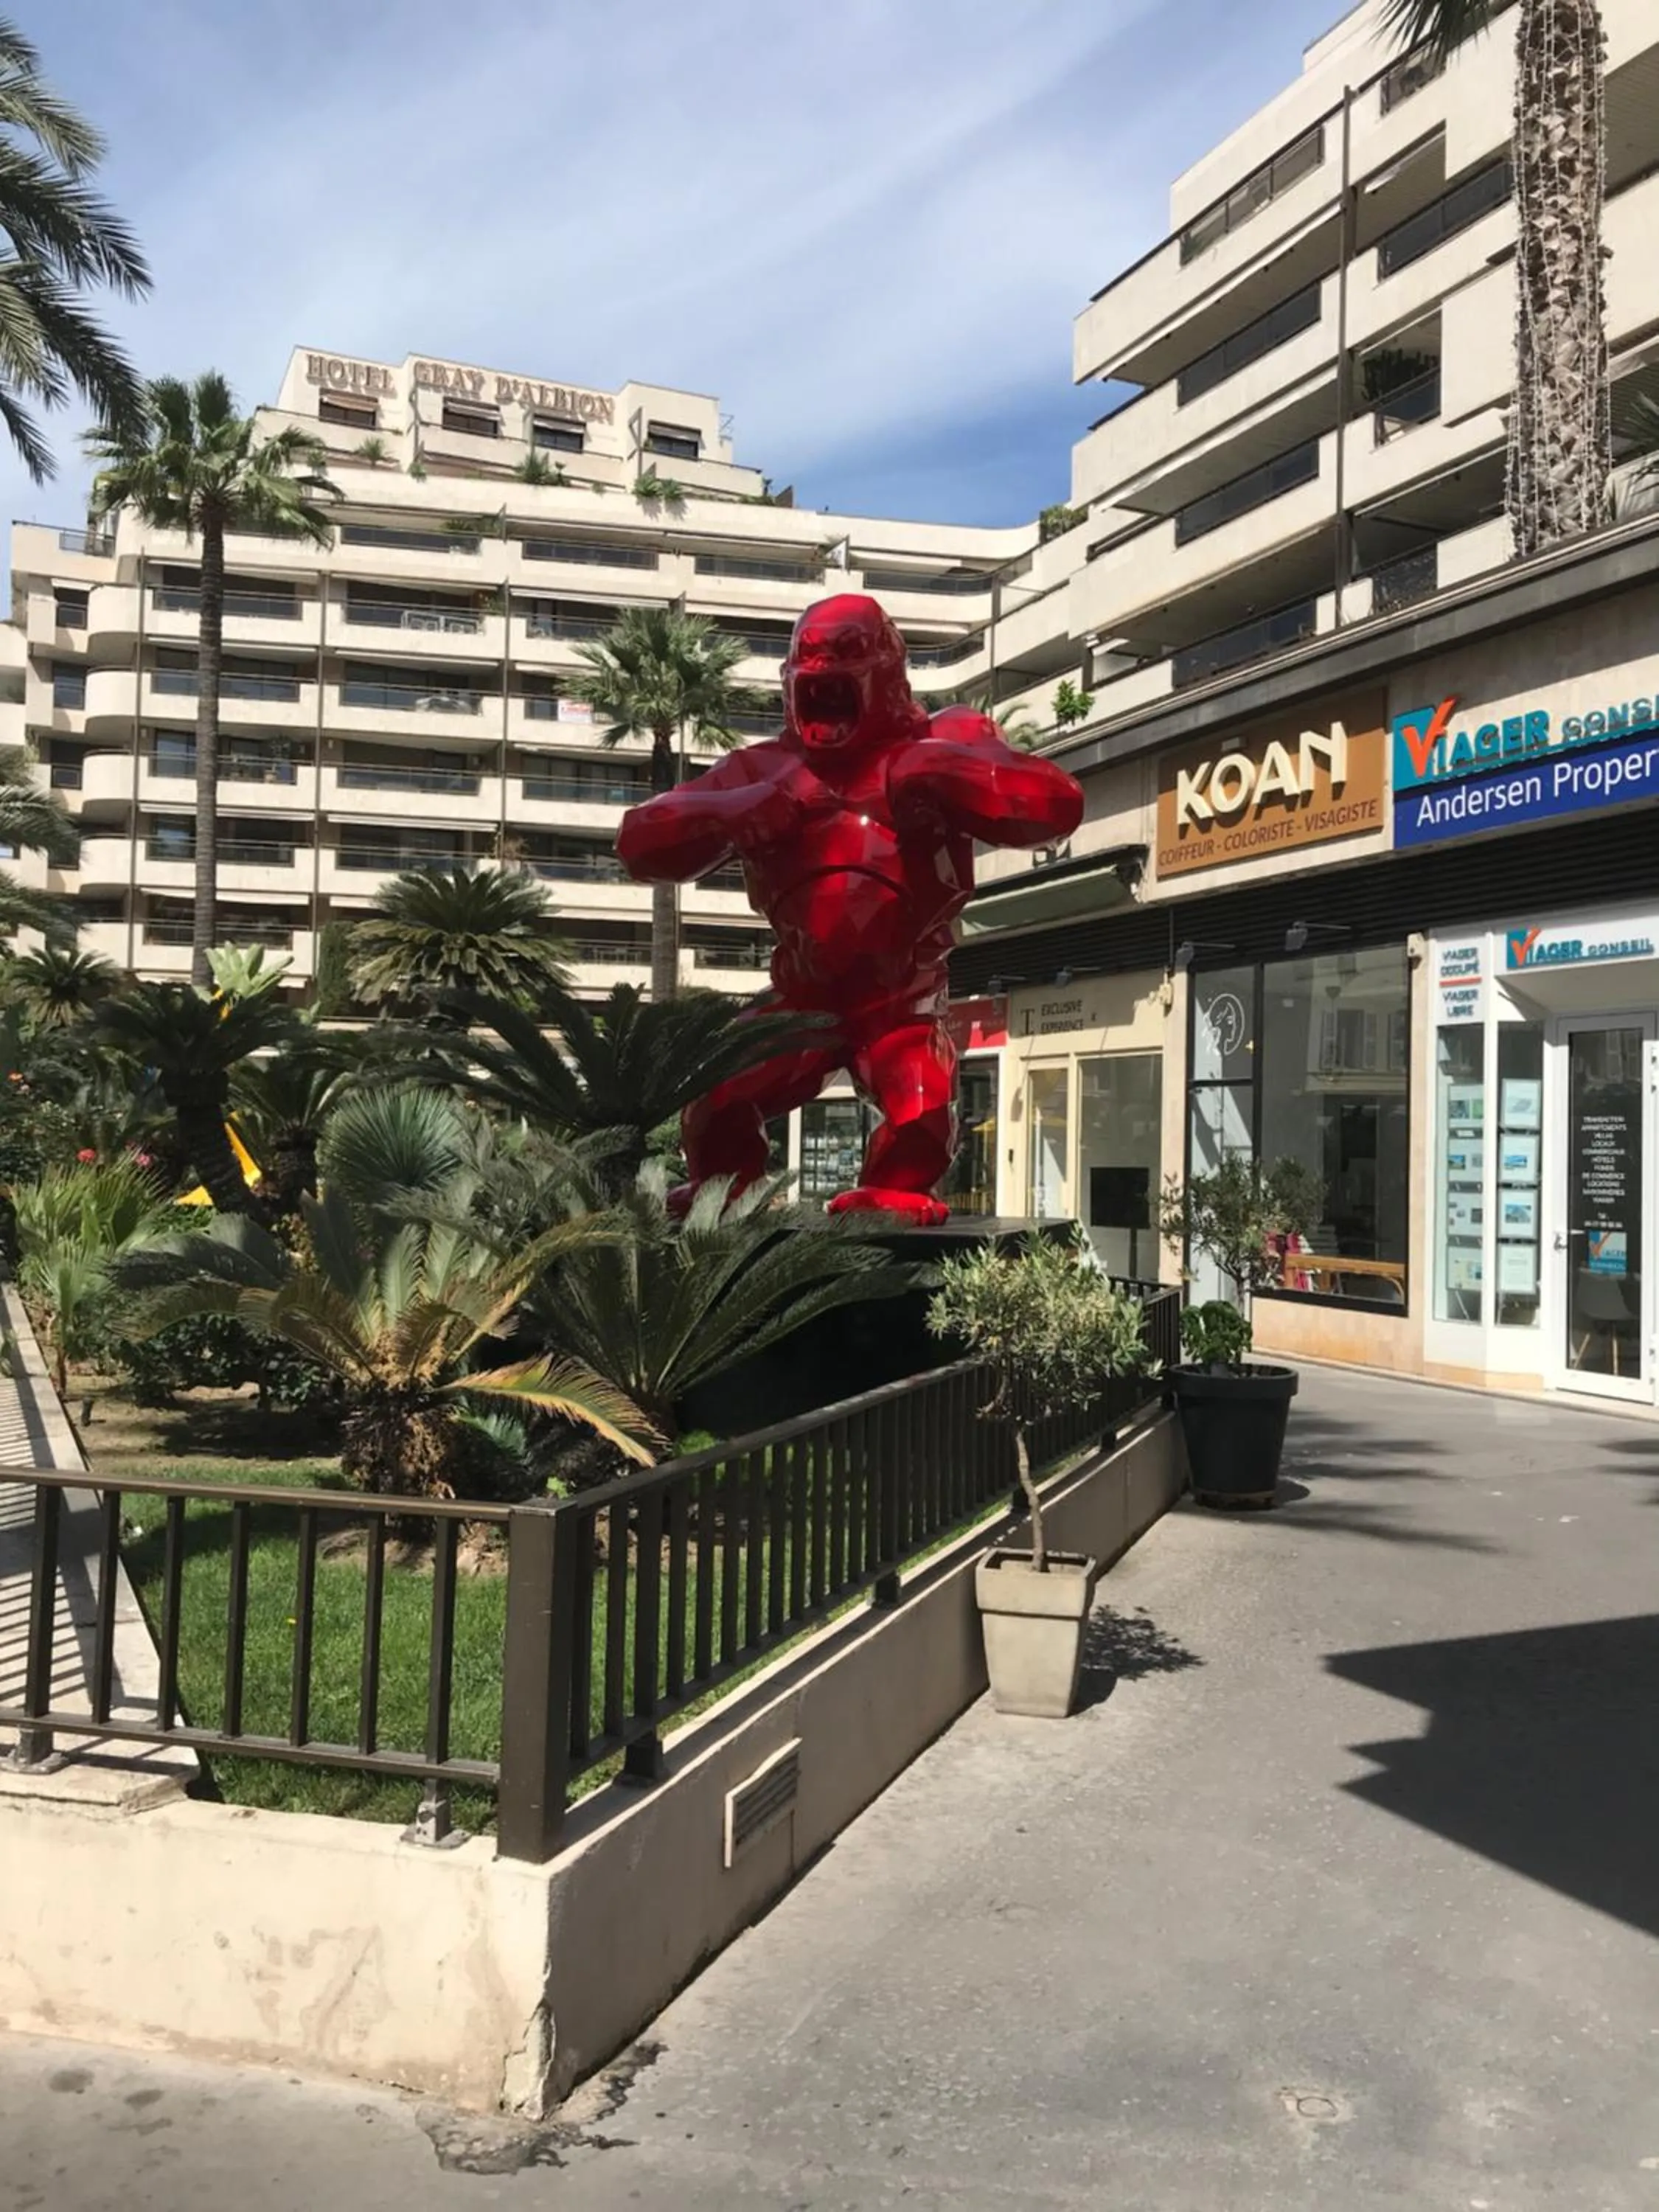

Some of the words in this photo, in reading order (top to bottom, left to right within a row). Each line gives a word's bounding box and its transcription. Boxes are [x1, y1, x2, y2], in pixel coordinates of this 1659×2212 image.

[307, 354, 394, 390] HOTEL
[414, 361, 486, 393] GRAY
[495, 375, 616, 416] D'ALBION
[1402, 694, 1550, 779] VIAGER
[1560, 694, 1659, 743] CONS
[1177, 721, 1349, 826] KOAN
[1416, 776, 1543, 828] Andersen
[1158, 839, 1215, 867] COIFFEUR
[1223, 819, 1295, 852] COLORISTE
[1304, 799, 1379, 832] VISAGISTE
[1442, 947, 1478, 961] VIAGER
[1511, 928, 1582, 967] VIAGER
[1587, 938, 1652, 956] CONSEIL
[1040, 999, 1082, 1017] EXCLUSIVE
[1442, 989, 1479, 1002] VIAGER
[1447, 1004, 1474, 1017] LIBRE
